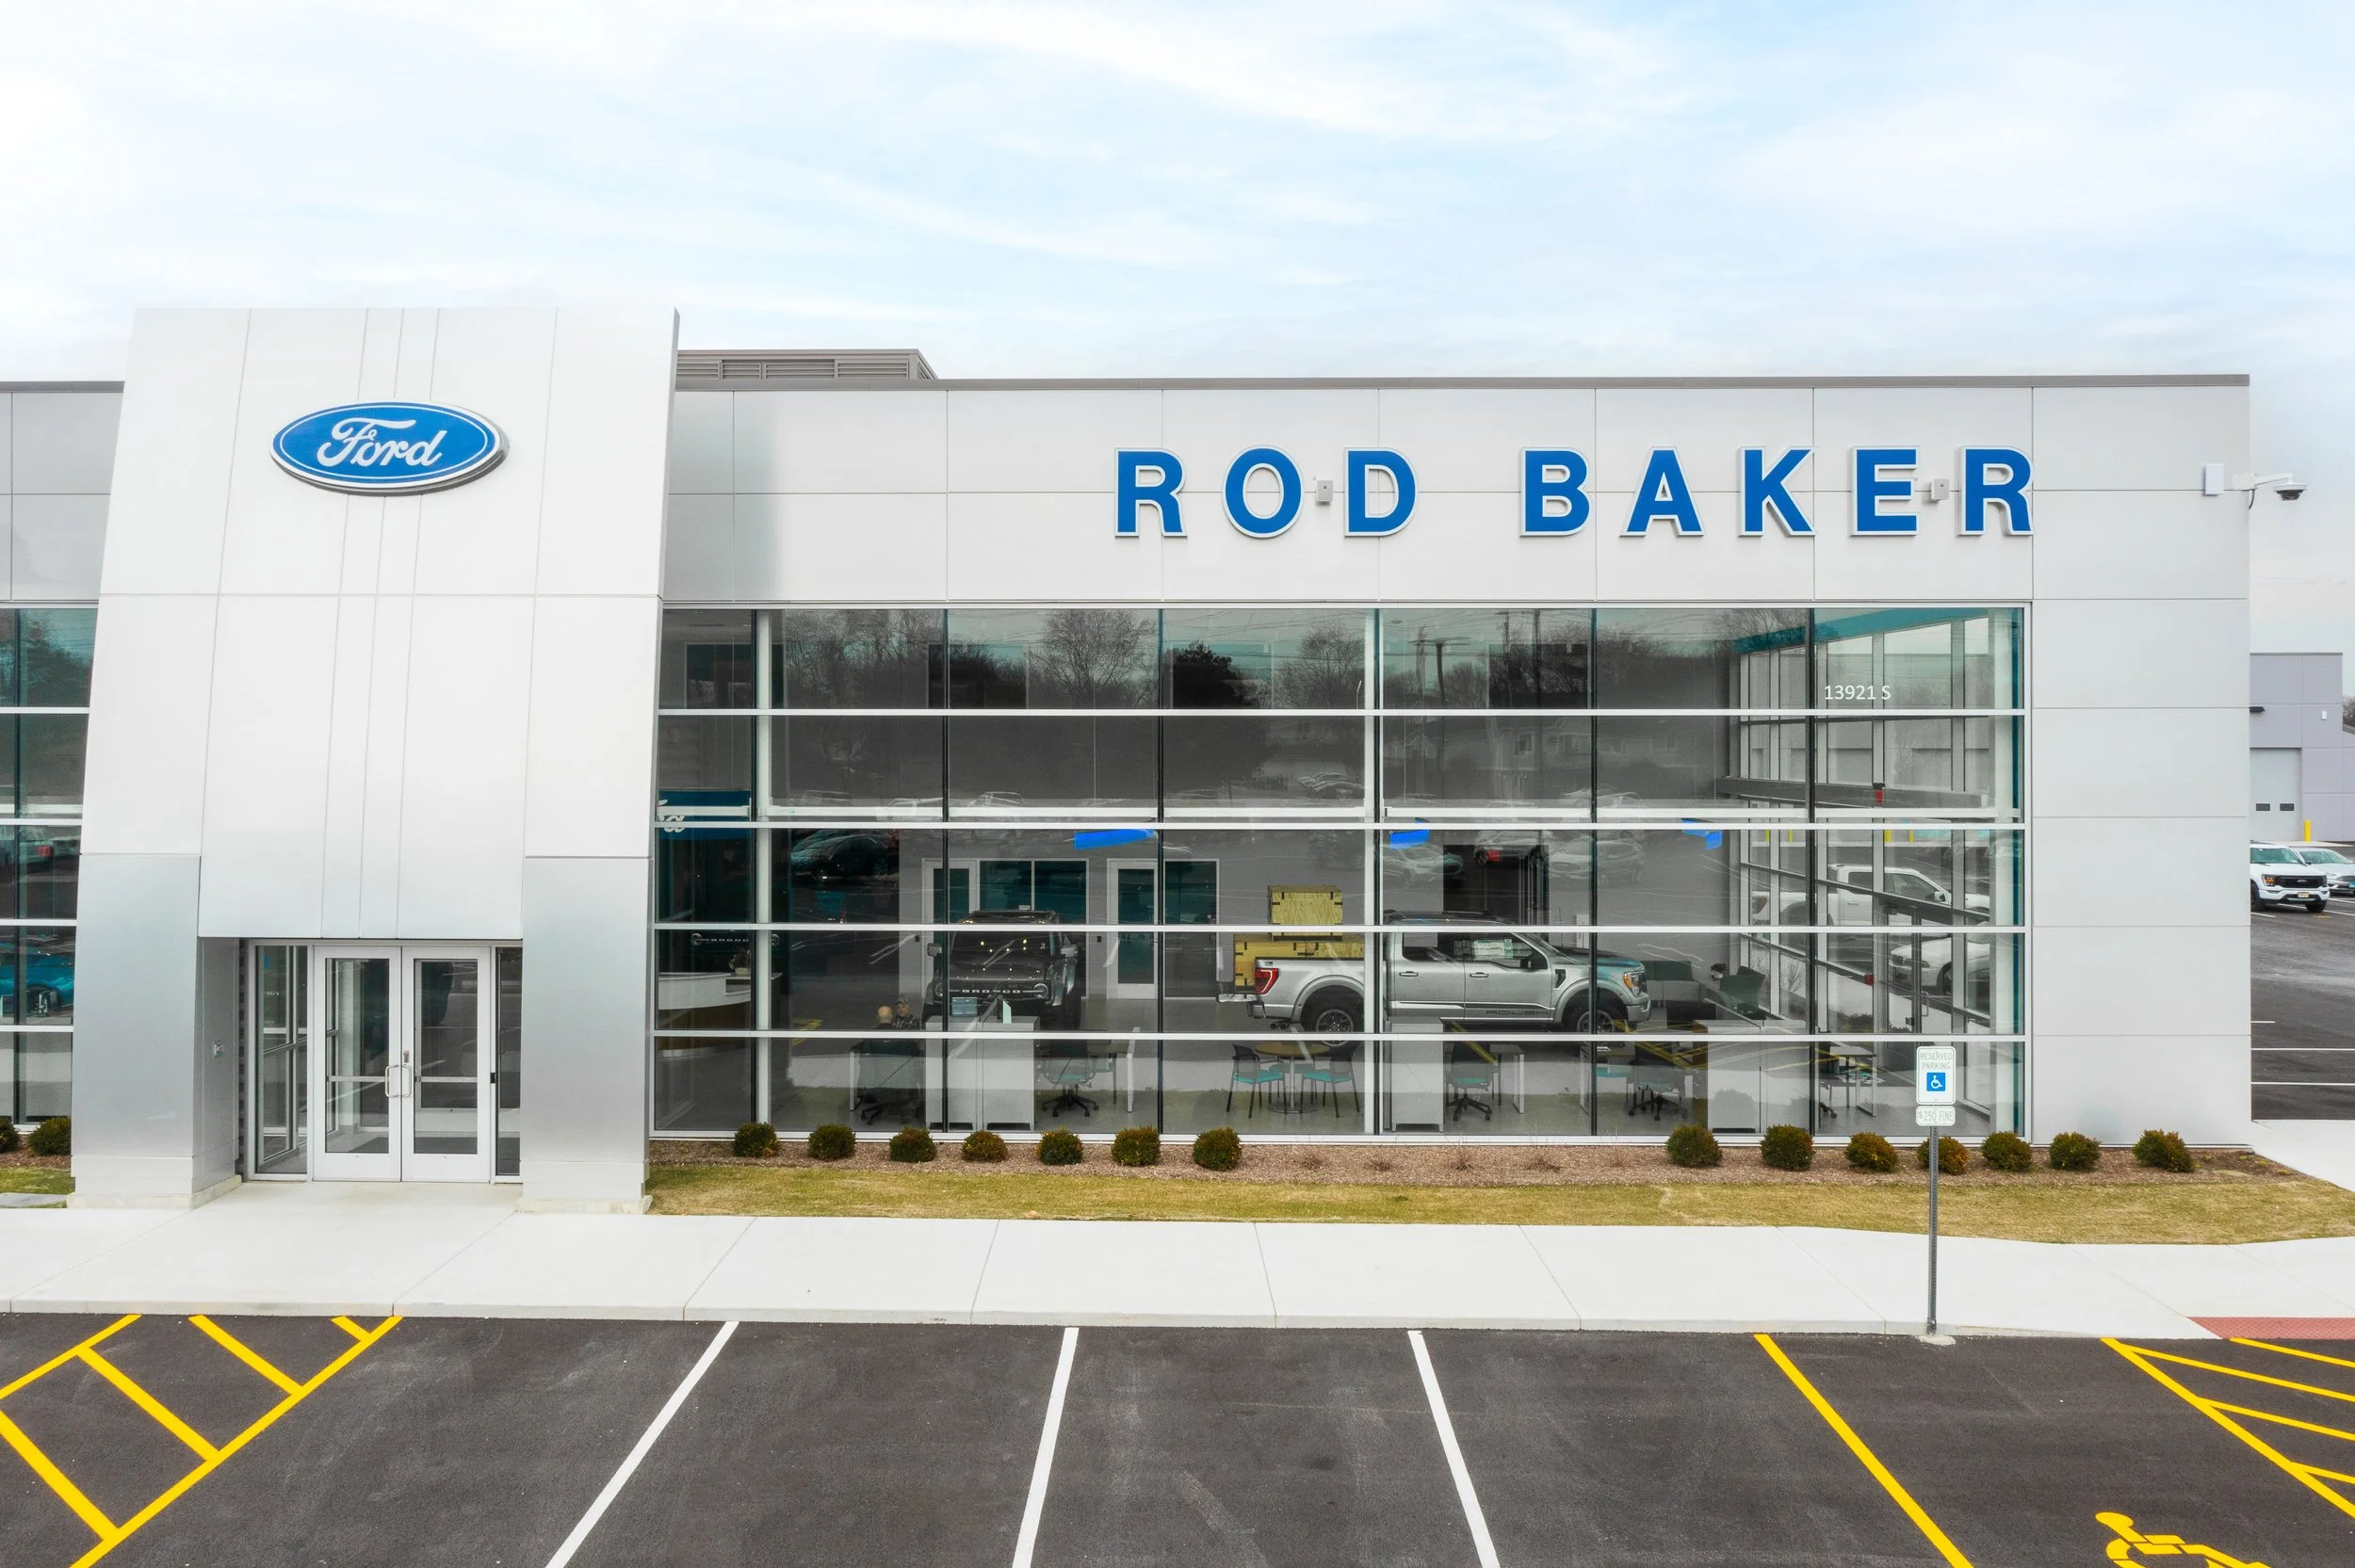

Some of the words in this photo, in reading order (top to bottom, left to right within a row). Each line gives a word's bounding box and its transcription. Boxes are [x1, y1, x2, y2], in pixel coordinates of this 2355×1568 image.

[317, 417, 447, 467] Ford
[1114, 445, 1418, 538] ROD
[1519, 445, 2034, 539] BAKER
[1824, 685, 1876, 701] 13921
[1881, 685, 1892, 701] S
[1922, 1061, 1951, 1070] PARKING
[1939, 1110, 1954, 1122] FINE
